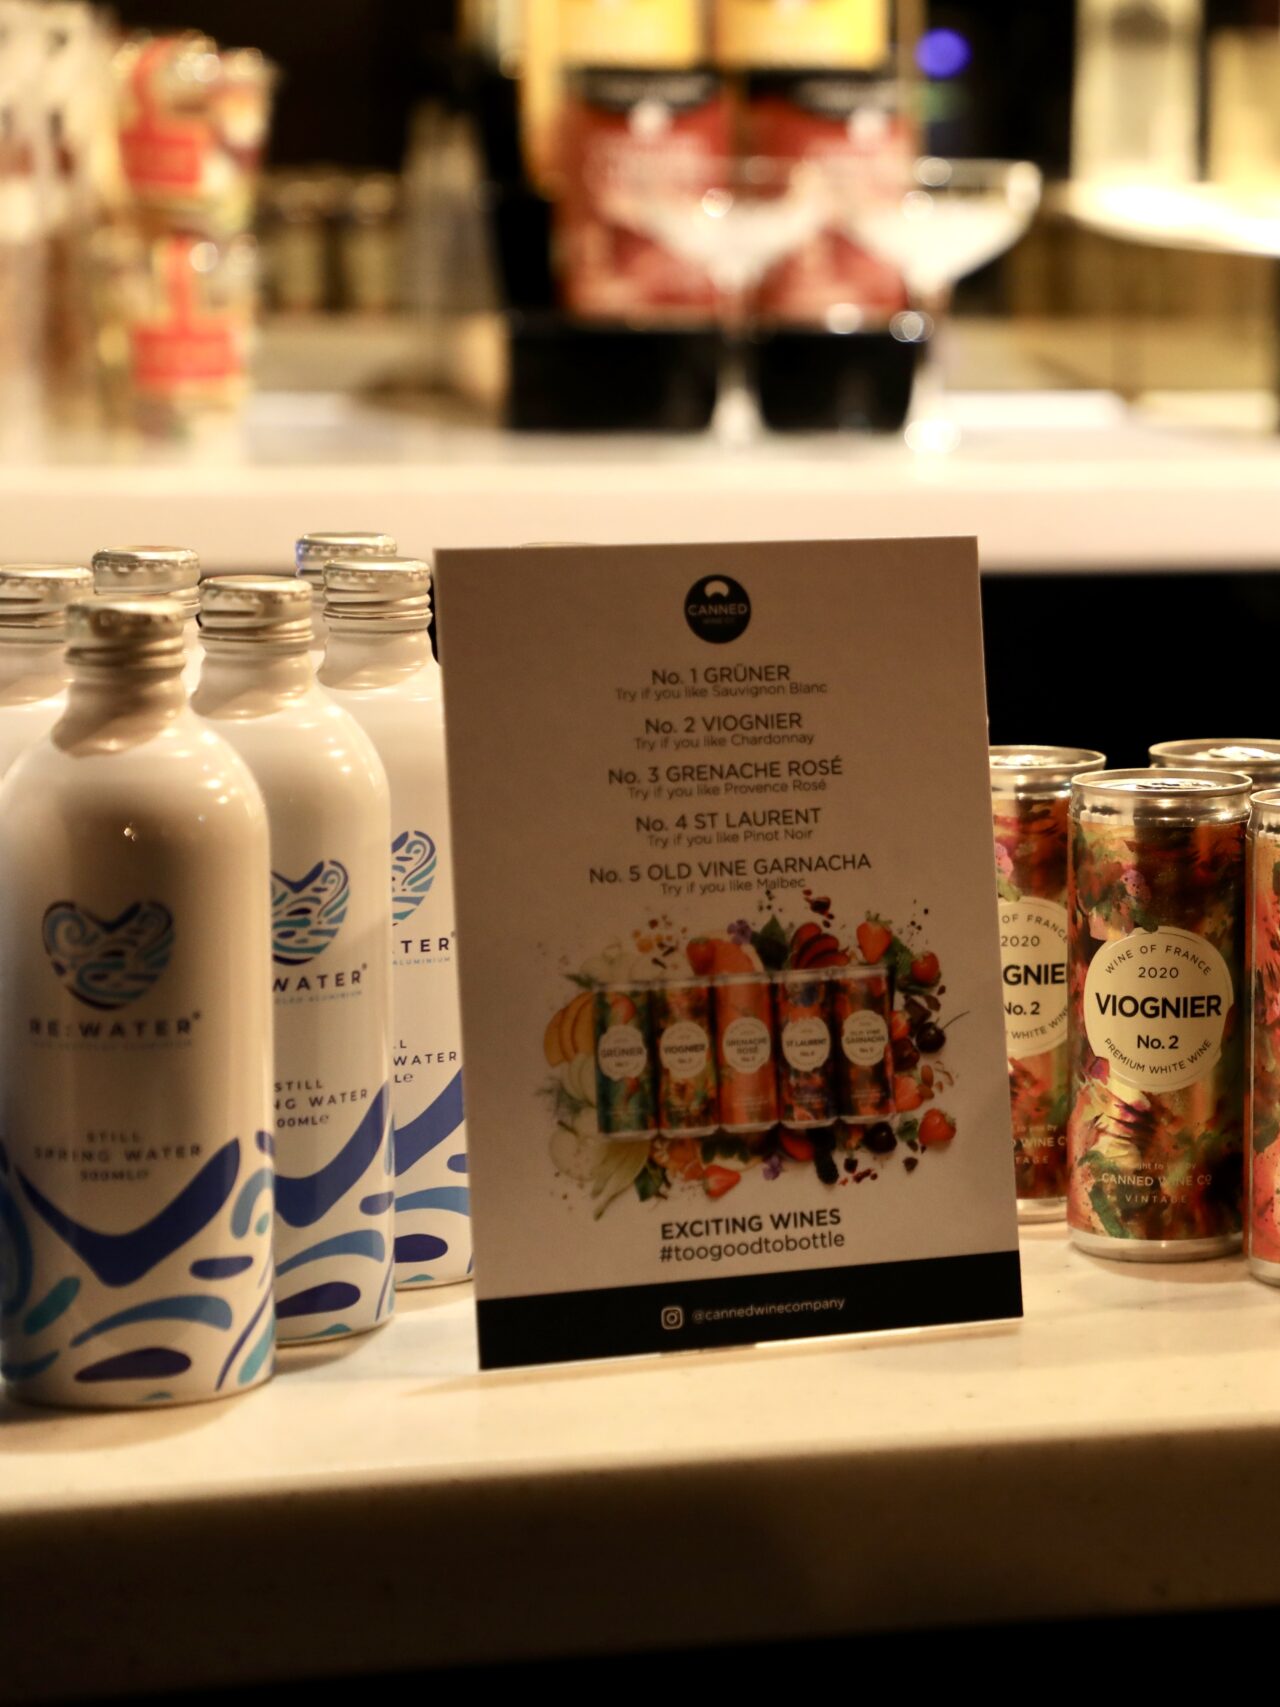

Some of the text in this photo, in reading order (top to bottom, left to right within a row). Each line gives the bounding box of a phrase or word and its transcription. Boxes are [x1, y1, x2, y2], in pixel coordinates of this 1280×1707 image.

[687, 602, 748, 617] CANNED
[652, 663, 791, 685] No. 1 GRÜNER
[616, 682, 828, 702] Try if you like Sauvignon Blanc
[645, 712, 803, 735] No. 2 VIOGNIER
[635, 732, 815, 751] Try if you like Chardonnay
[608, 755, 843, 785] No. 3 GRENACHE ROSÉ
[627, 778, 827, 801] Try if you like Provence Rosé
[636, 807, 821, 833] No. 4 ST LAURENT
[648, 827, 813, 849] Try if you like Pinot Noir
[589, 853, 871, 884] No. 5 OLD VINE GARNACHA
[660, 876, 806, 897] Try if you like Malbec
[1001, 913, 1019, 924] OF
[1000, 934, 1040, 947] 2020
[1105, 944, 1212, 976] WINE OF FRANCE
[1138, 967, 1179, 979] 2020
[1095, 992, 1222, 1019] VIOGNIER
[1011, 1024, 1047, 1039] WHITE
[1105, 1037, 1212, 1075] PREMIUM WHITE WINE
[274, 1078, 323, 1093] STILL
[308, 1088, 368, 1108] WATER
[1020, 1137, 1055, 1147] WINE
[1101, 1172, 1154, 1187] CANNED
[661, 1208, 841, 1240] EXCITING WINES
[660, 1231, 845, 1262] #toogoodtobottle
[693, 1297, 845, 1322] @cannedwinecompany
